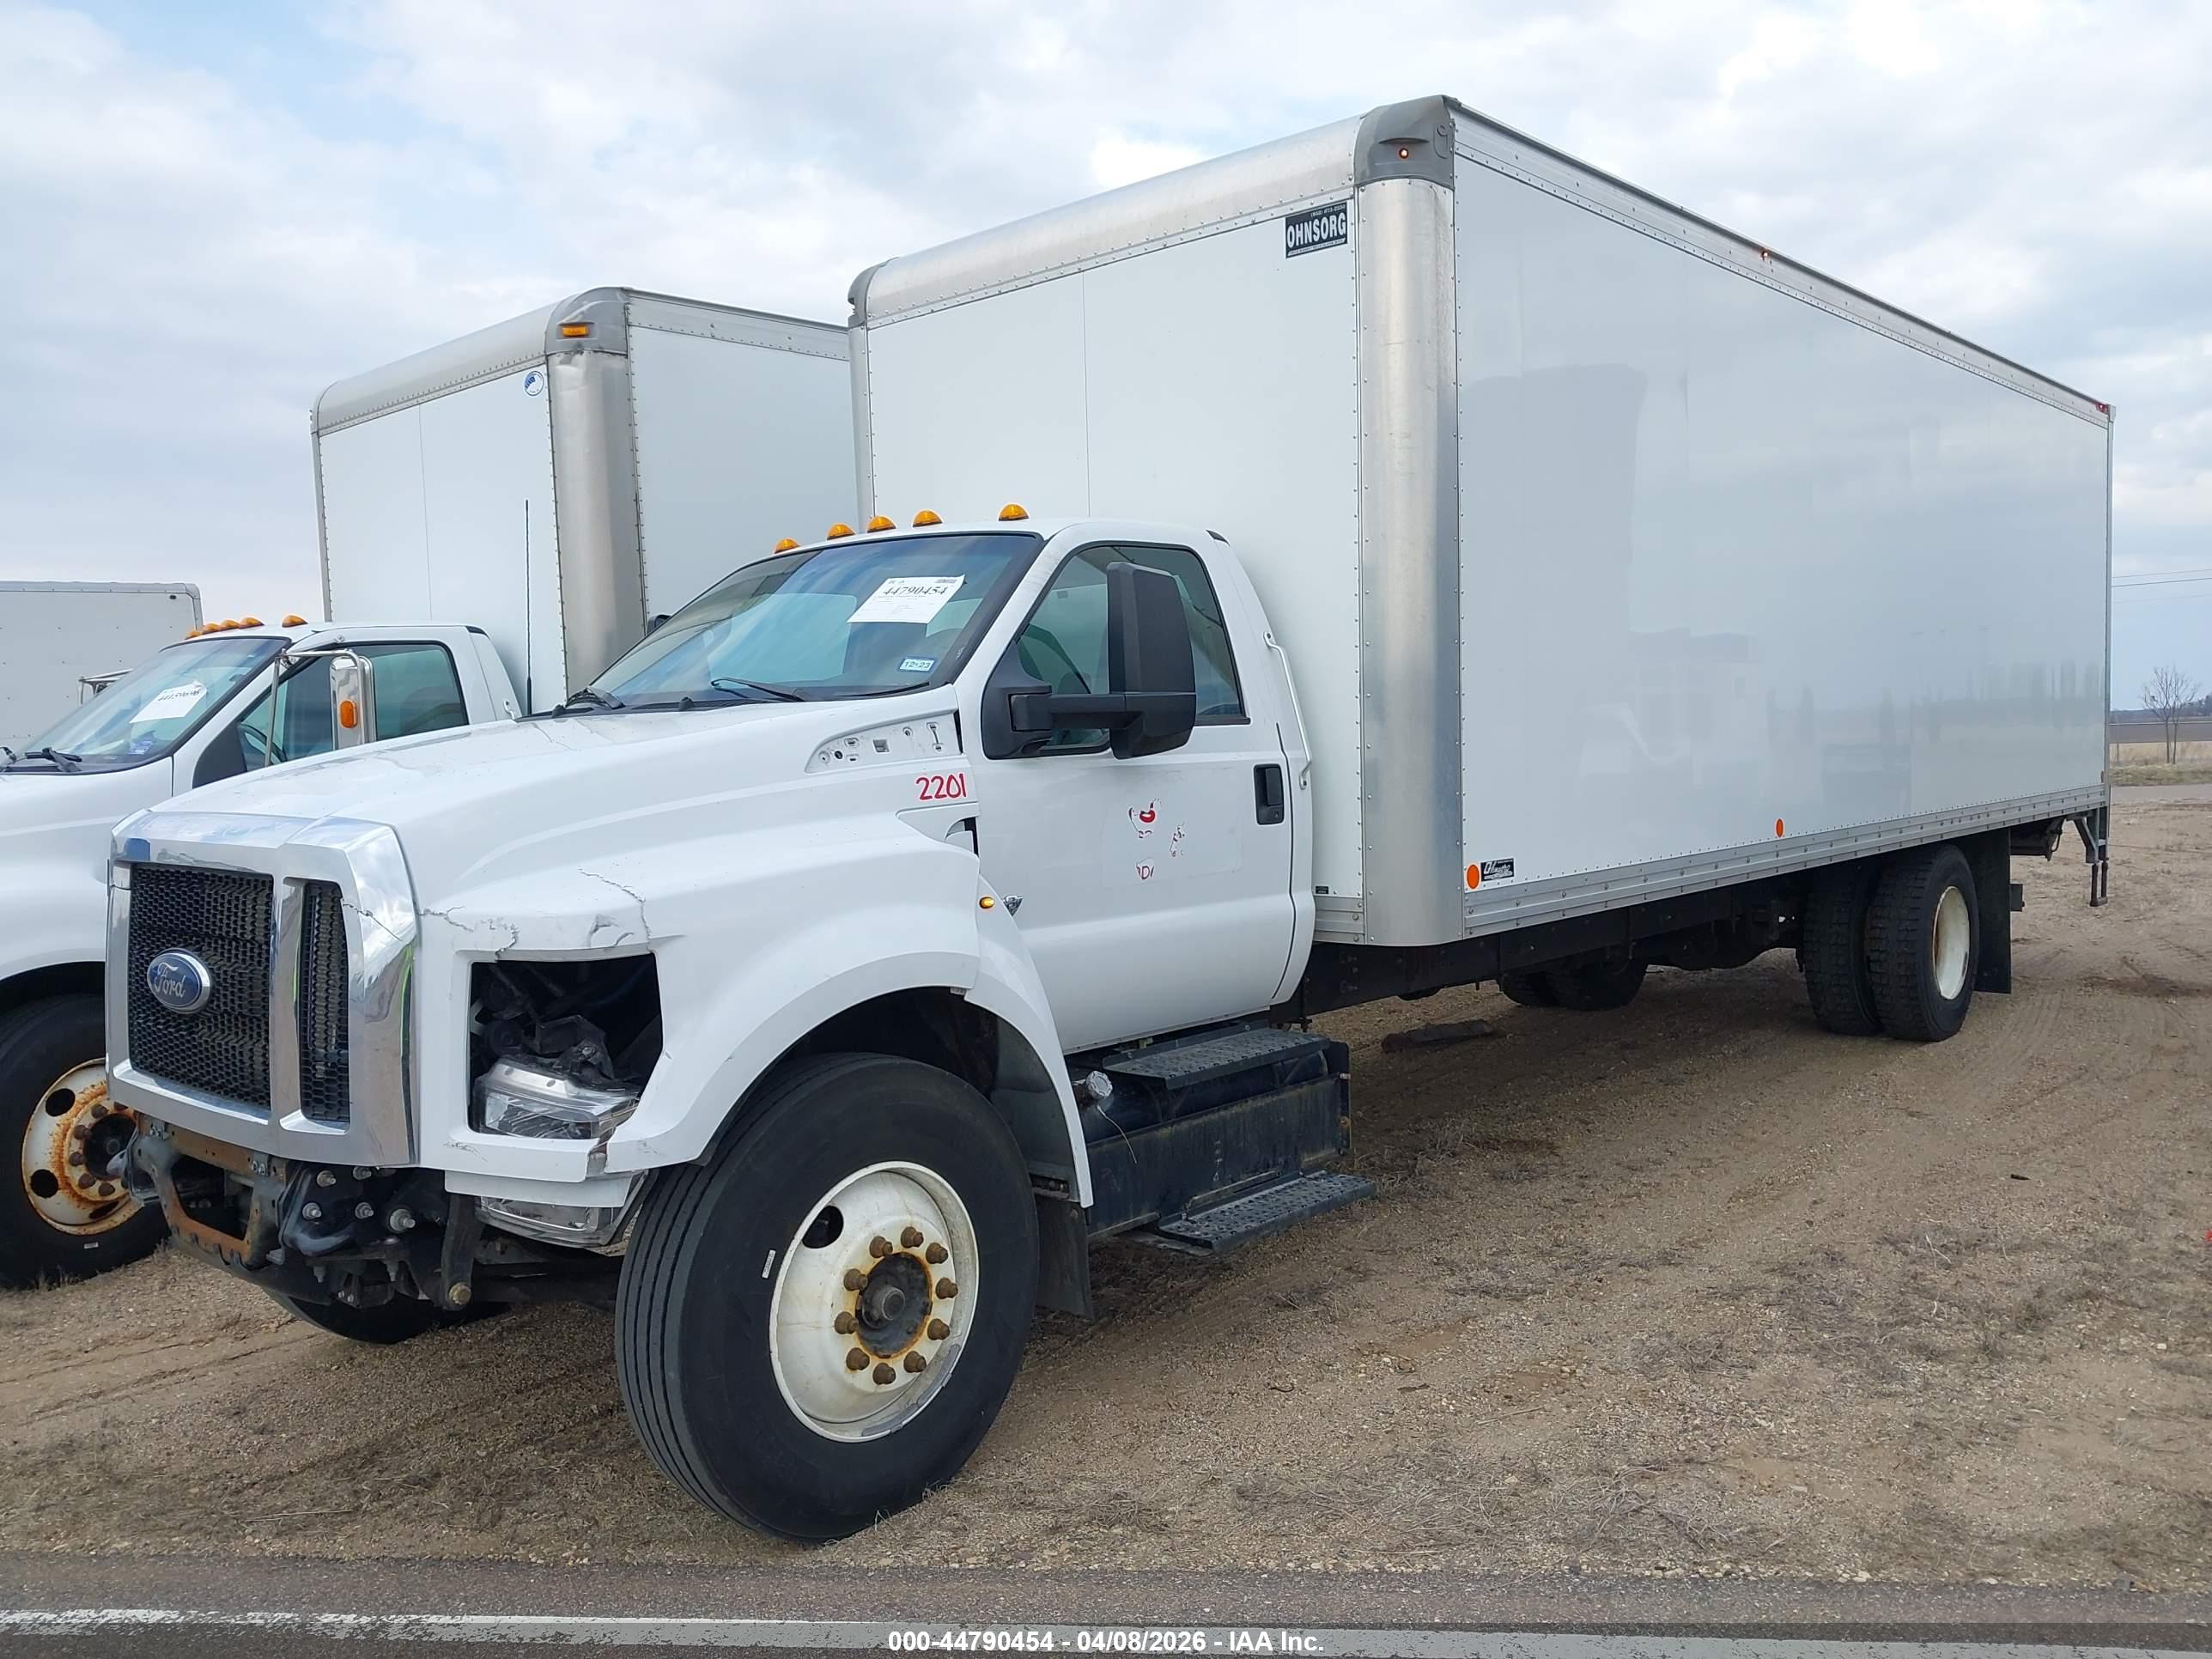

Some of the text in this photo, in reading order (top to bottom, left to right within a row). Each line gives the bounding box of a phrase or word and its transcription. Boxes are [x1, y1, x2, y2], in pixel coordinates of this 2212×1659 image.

[1287, 212, 1346, 248] OHNSORG
[883, 585, 949, 596] 44790454
[915, 773, 967, 800] 2201
[154, 962, 187, 999] Ford
